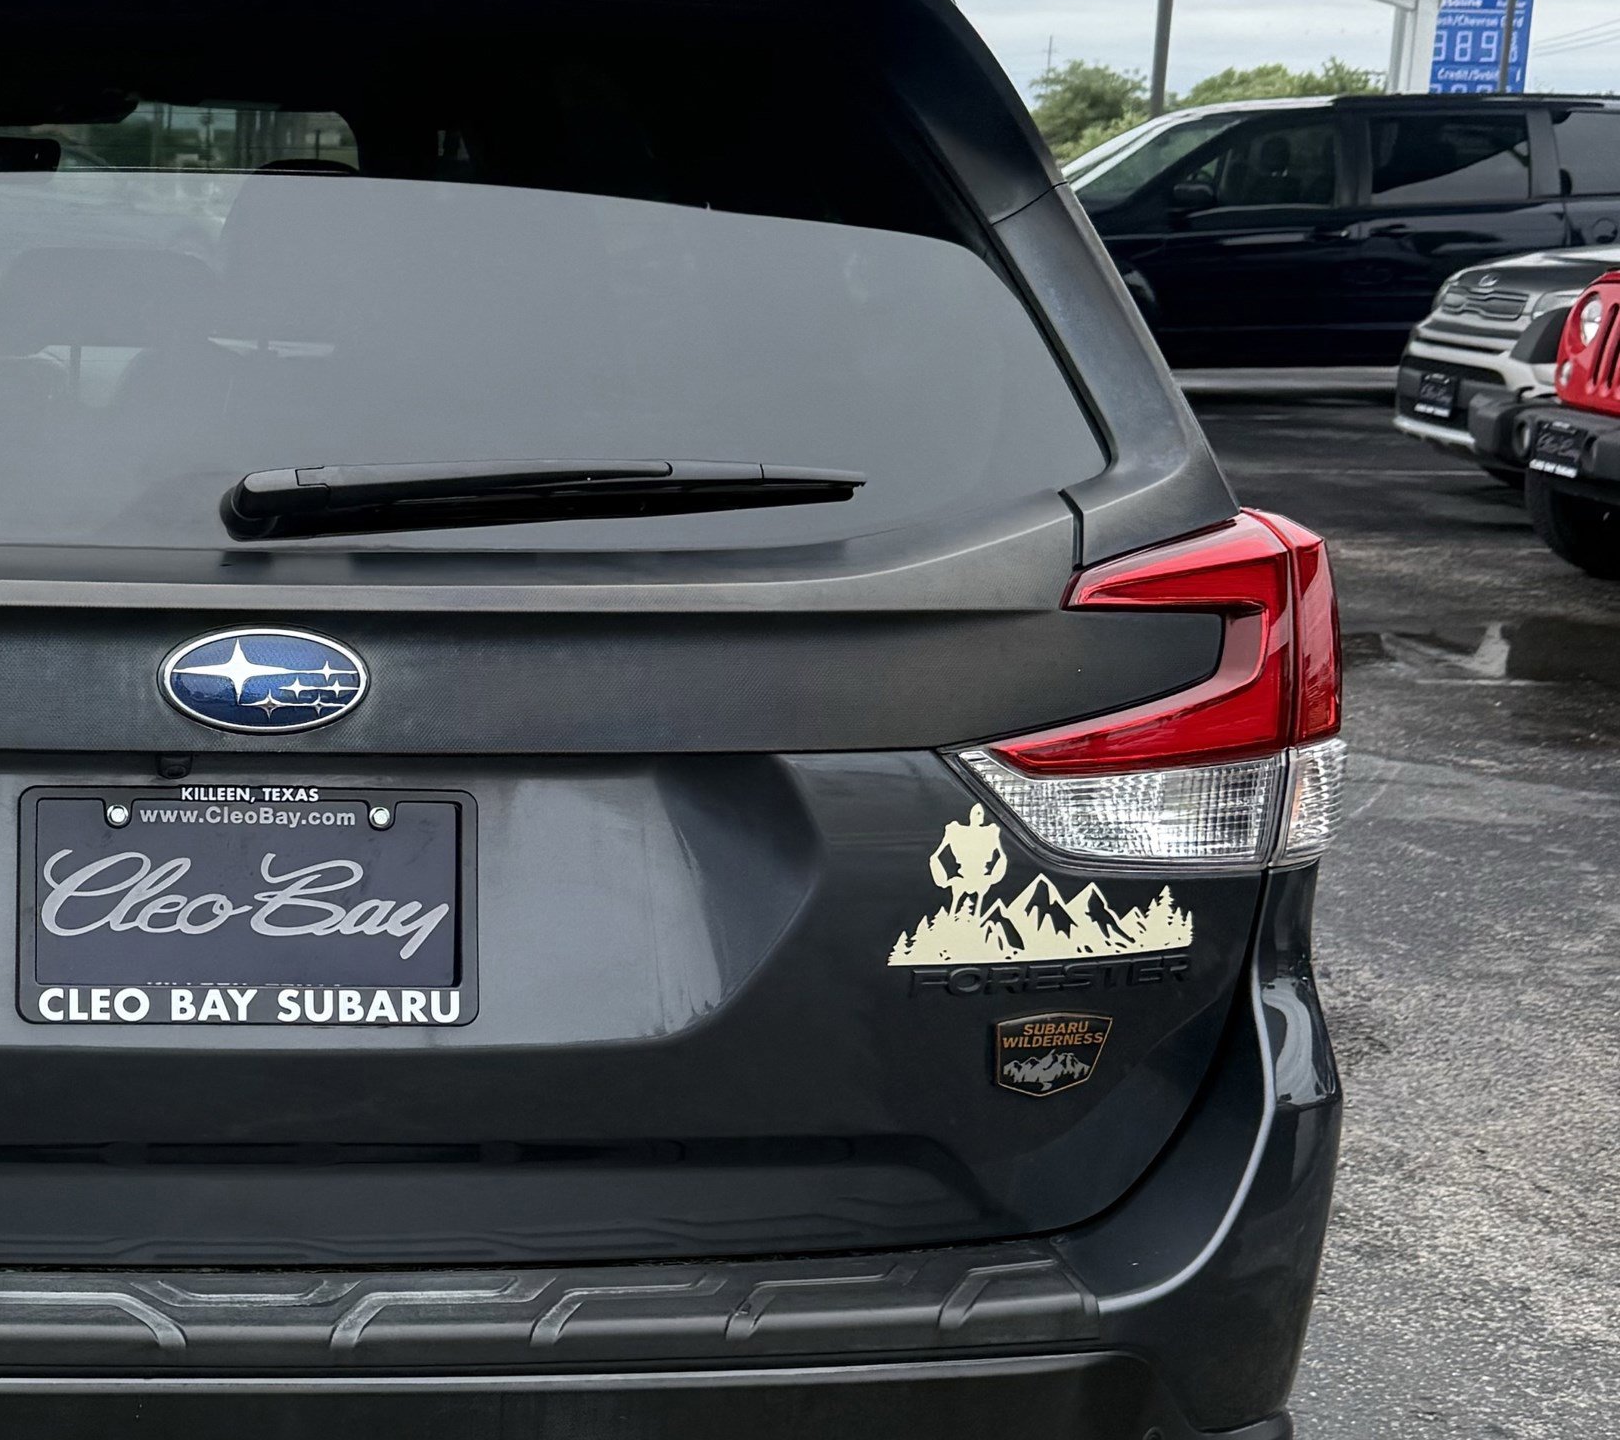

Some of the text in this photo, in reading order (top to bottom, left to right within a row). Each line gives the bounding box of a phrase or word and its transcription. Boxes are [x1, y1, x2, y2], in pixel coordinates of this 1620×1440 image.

[181, 786, 319, 803] KILLEEN, TEXAS
[139, 806, 356, 828] www.CleoBay.com
[41, 849, 449, 960] Cleo Bay
[907, 953, 1192, 996] FORESTER
[37, 988, 461, 1023] CLEO BAY SUBARU
[1023, 1020, 1089, 1036] SUBARU
[1002, 1032, 1104, 1049] WILDERNESS
